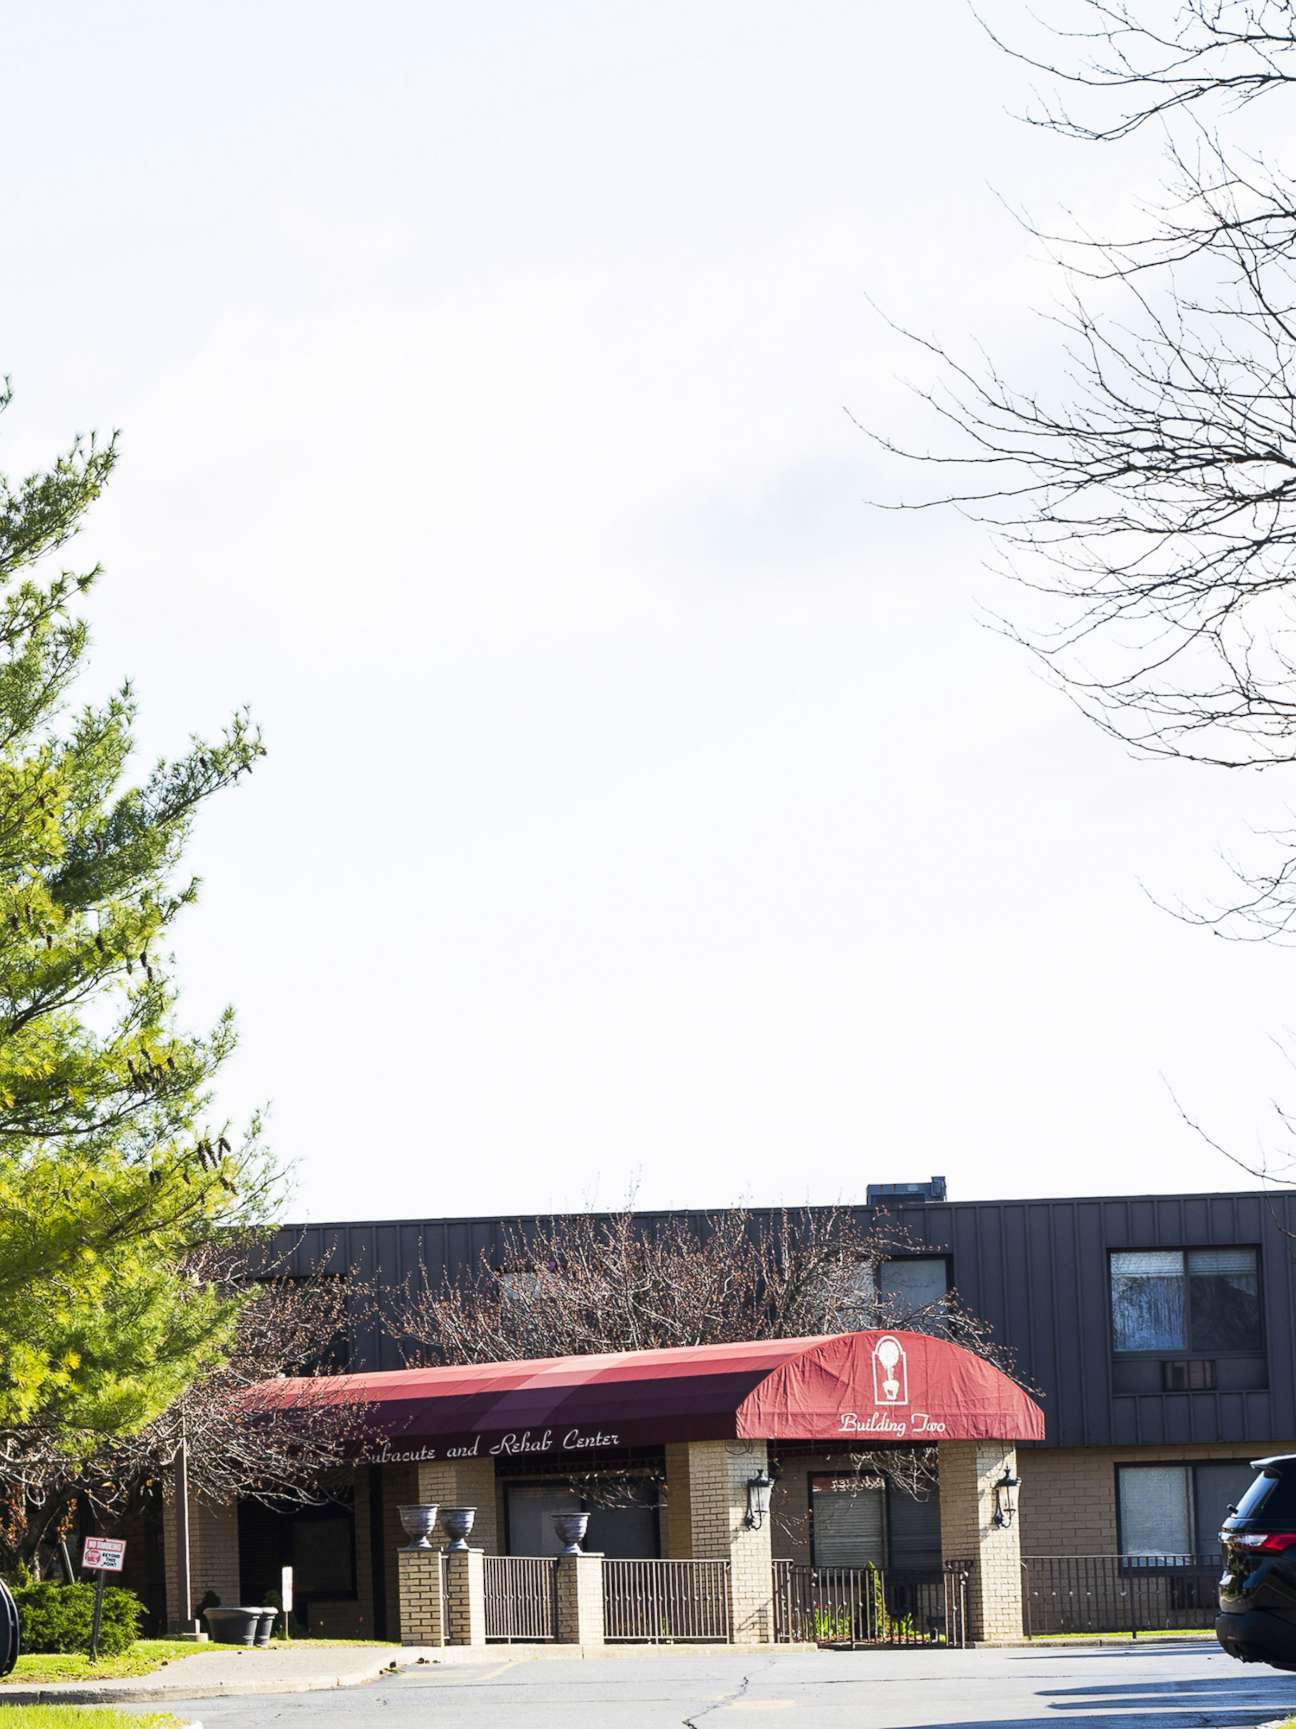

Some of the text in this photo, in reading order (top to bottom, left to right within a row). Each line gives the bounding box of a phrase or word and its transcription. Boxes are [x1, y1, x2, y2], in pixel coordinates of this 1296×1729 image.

[837, 1411, 946, 1437] Building Two
[446, 1434, 481, 1458] and
[489, 1429, 553, 1456] Rehab
[562, 1428, 621, 1450] Center
